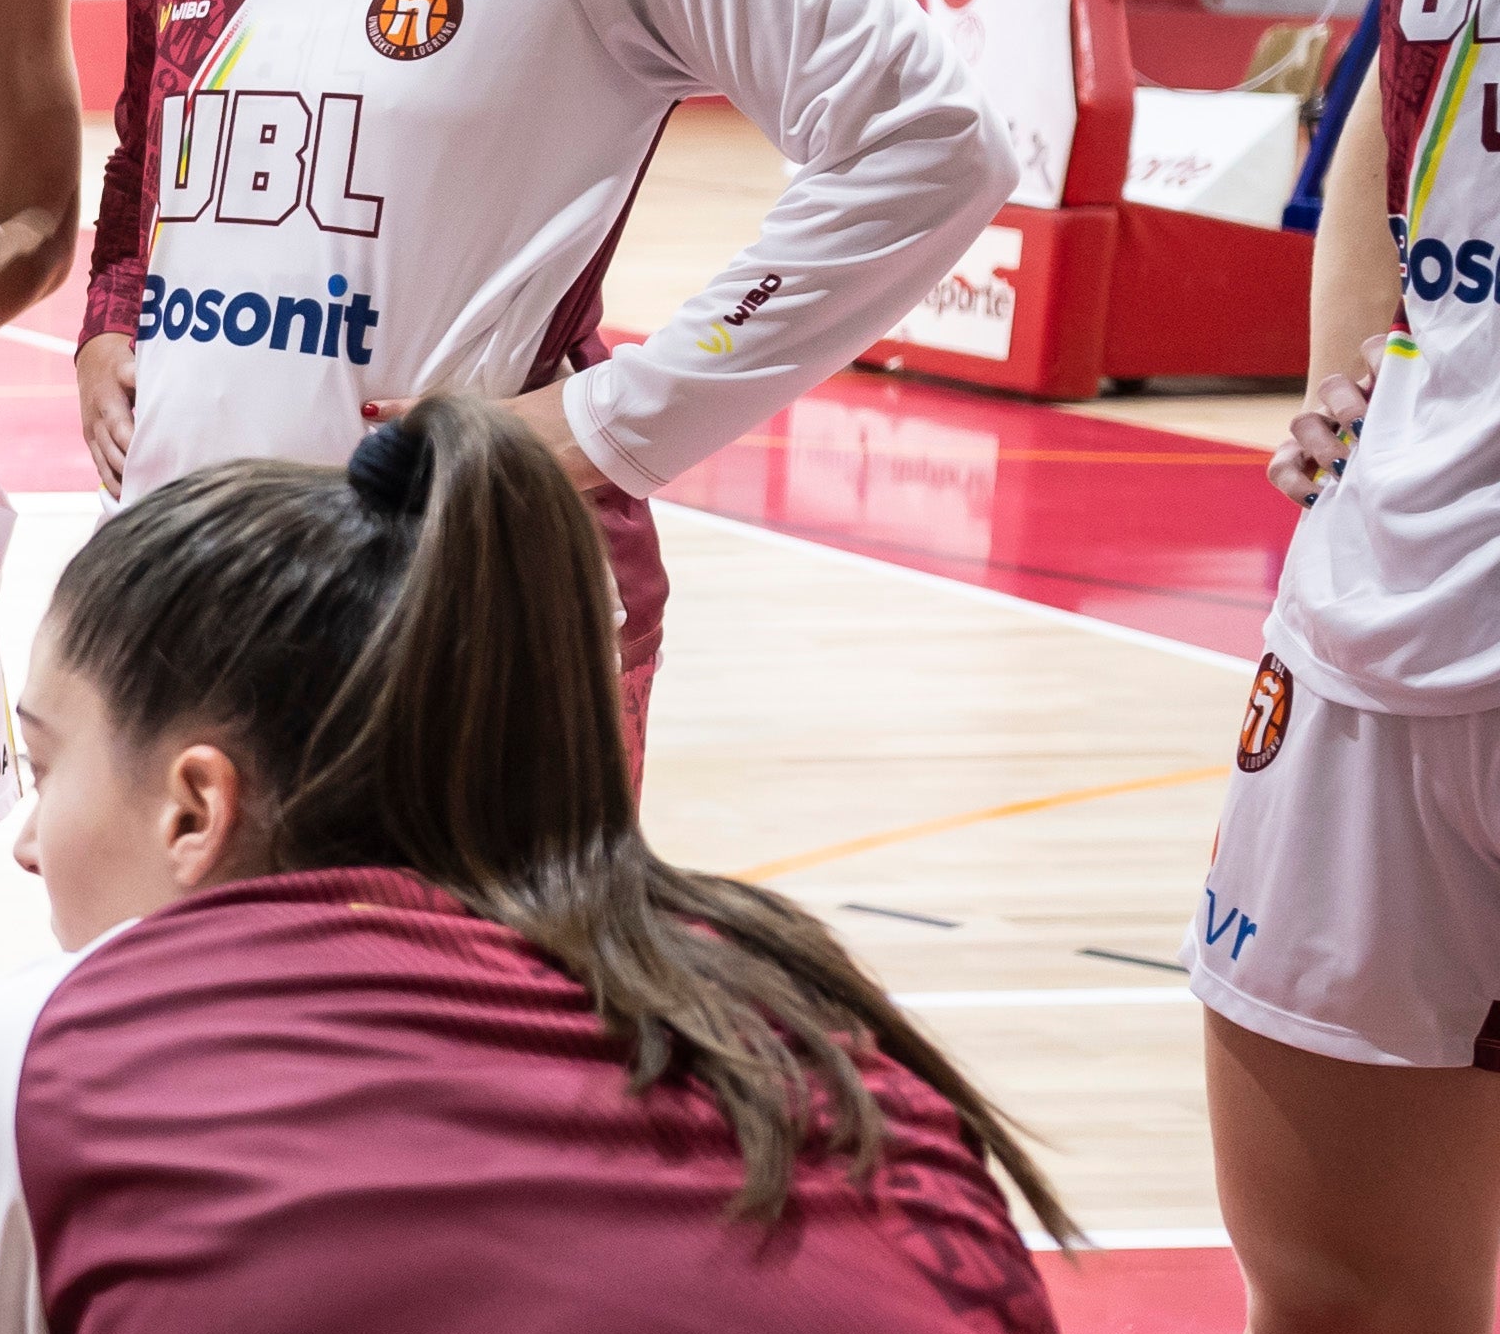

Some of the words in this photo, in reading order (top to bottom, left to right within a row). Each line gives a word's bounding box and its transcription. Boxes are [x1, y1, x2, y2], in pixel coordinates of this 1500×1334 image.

[171, 0, 211, 21] WIBO
[155, 90, 385, 239] UBL
[723, 273, 782, 326] WIBO
[1205, 886, 1256, 961] vr
